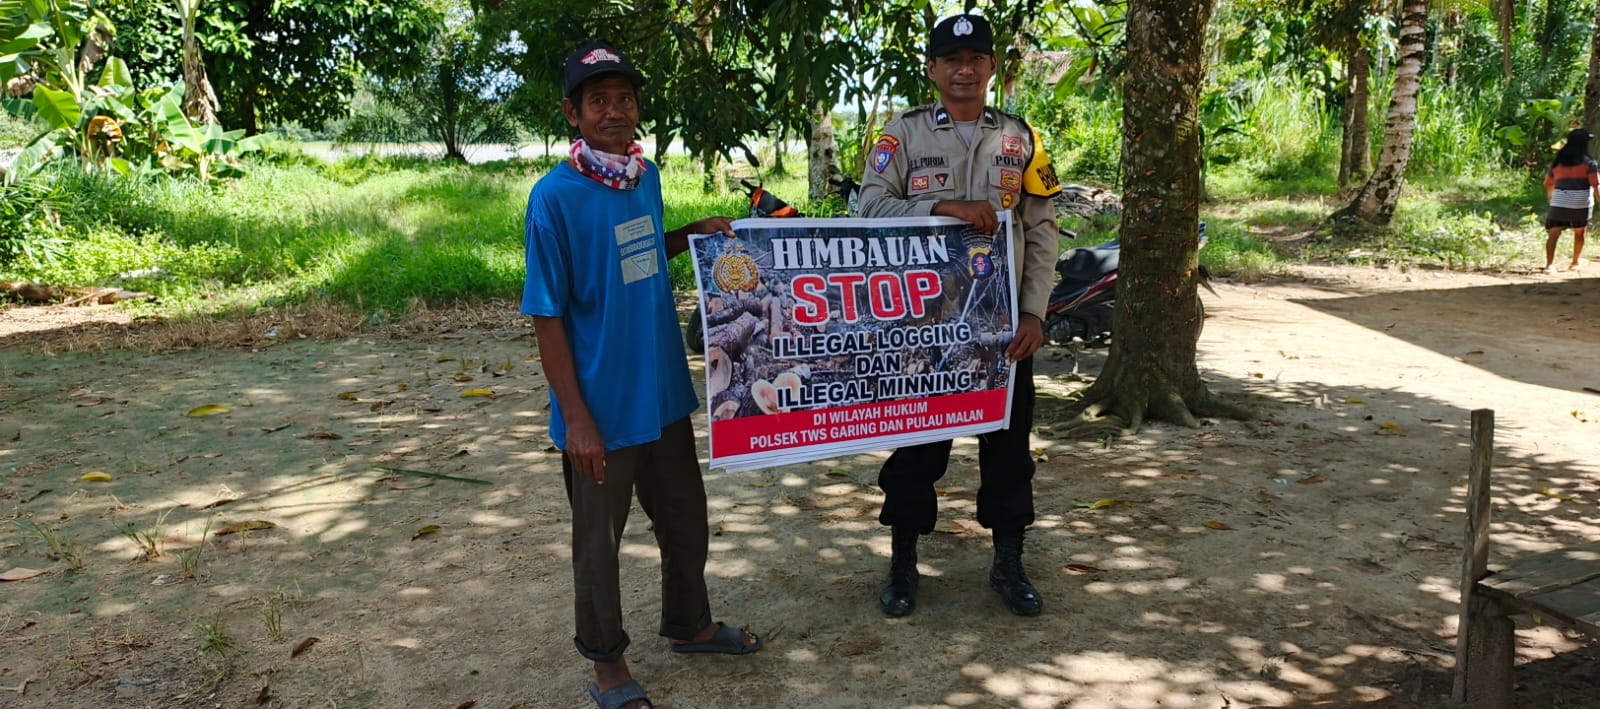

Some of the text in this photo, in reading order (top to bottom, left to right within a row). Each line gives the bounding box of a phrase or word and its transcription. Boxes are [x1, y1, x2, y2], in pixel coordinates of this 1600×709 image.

[771, 235, 950, 270] HIMBAUAN
[791, 269, 942, 326] STOP
[773, 322, 971, 359] ILLEGAL LOGGING
[855, 352, 901, 377] DAN
[776, 370, 971, 410] ILLEGAL MINNING
[750, 409, 984, 449] POLSEK TWS GARING DAN PULAU MALAN
[813, 401, 928, 426] DI WILAYAH HUKUM
